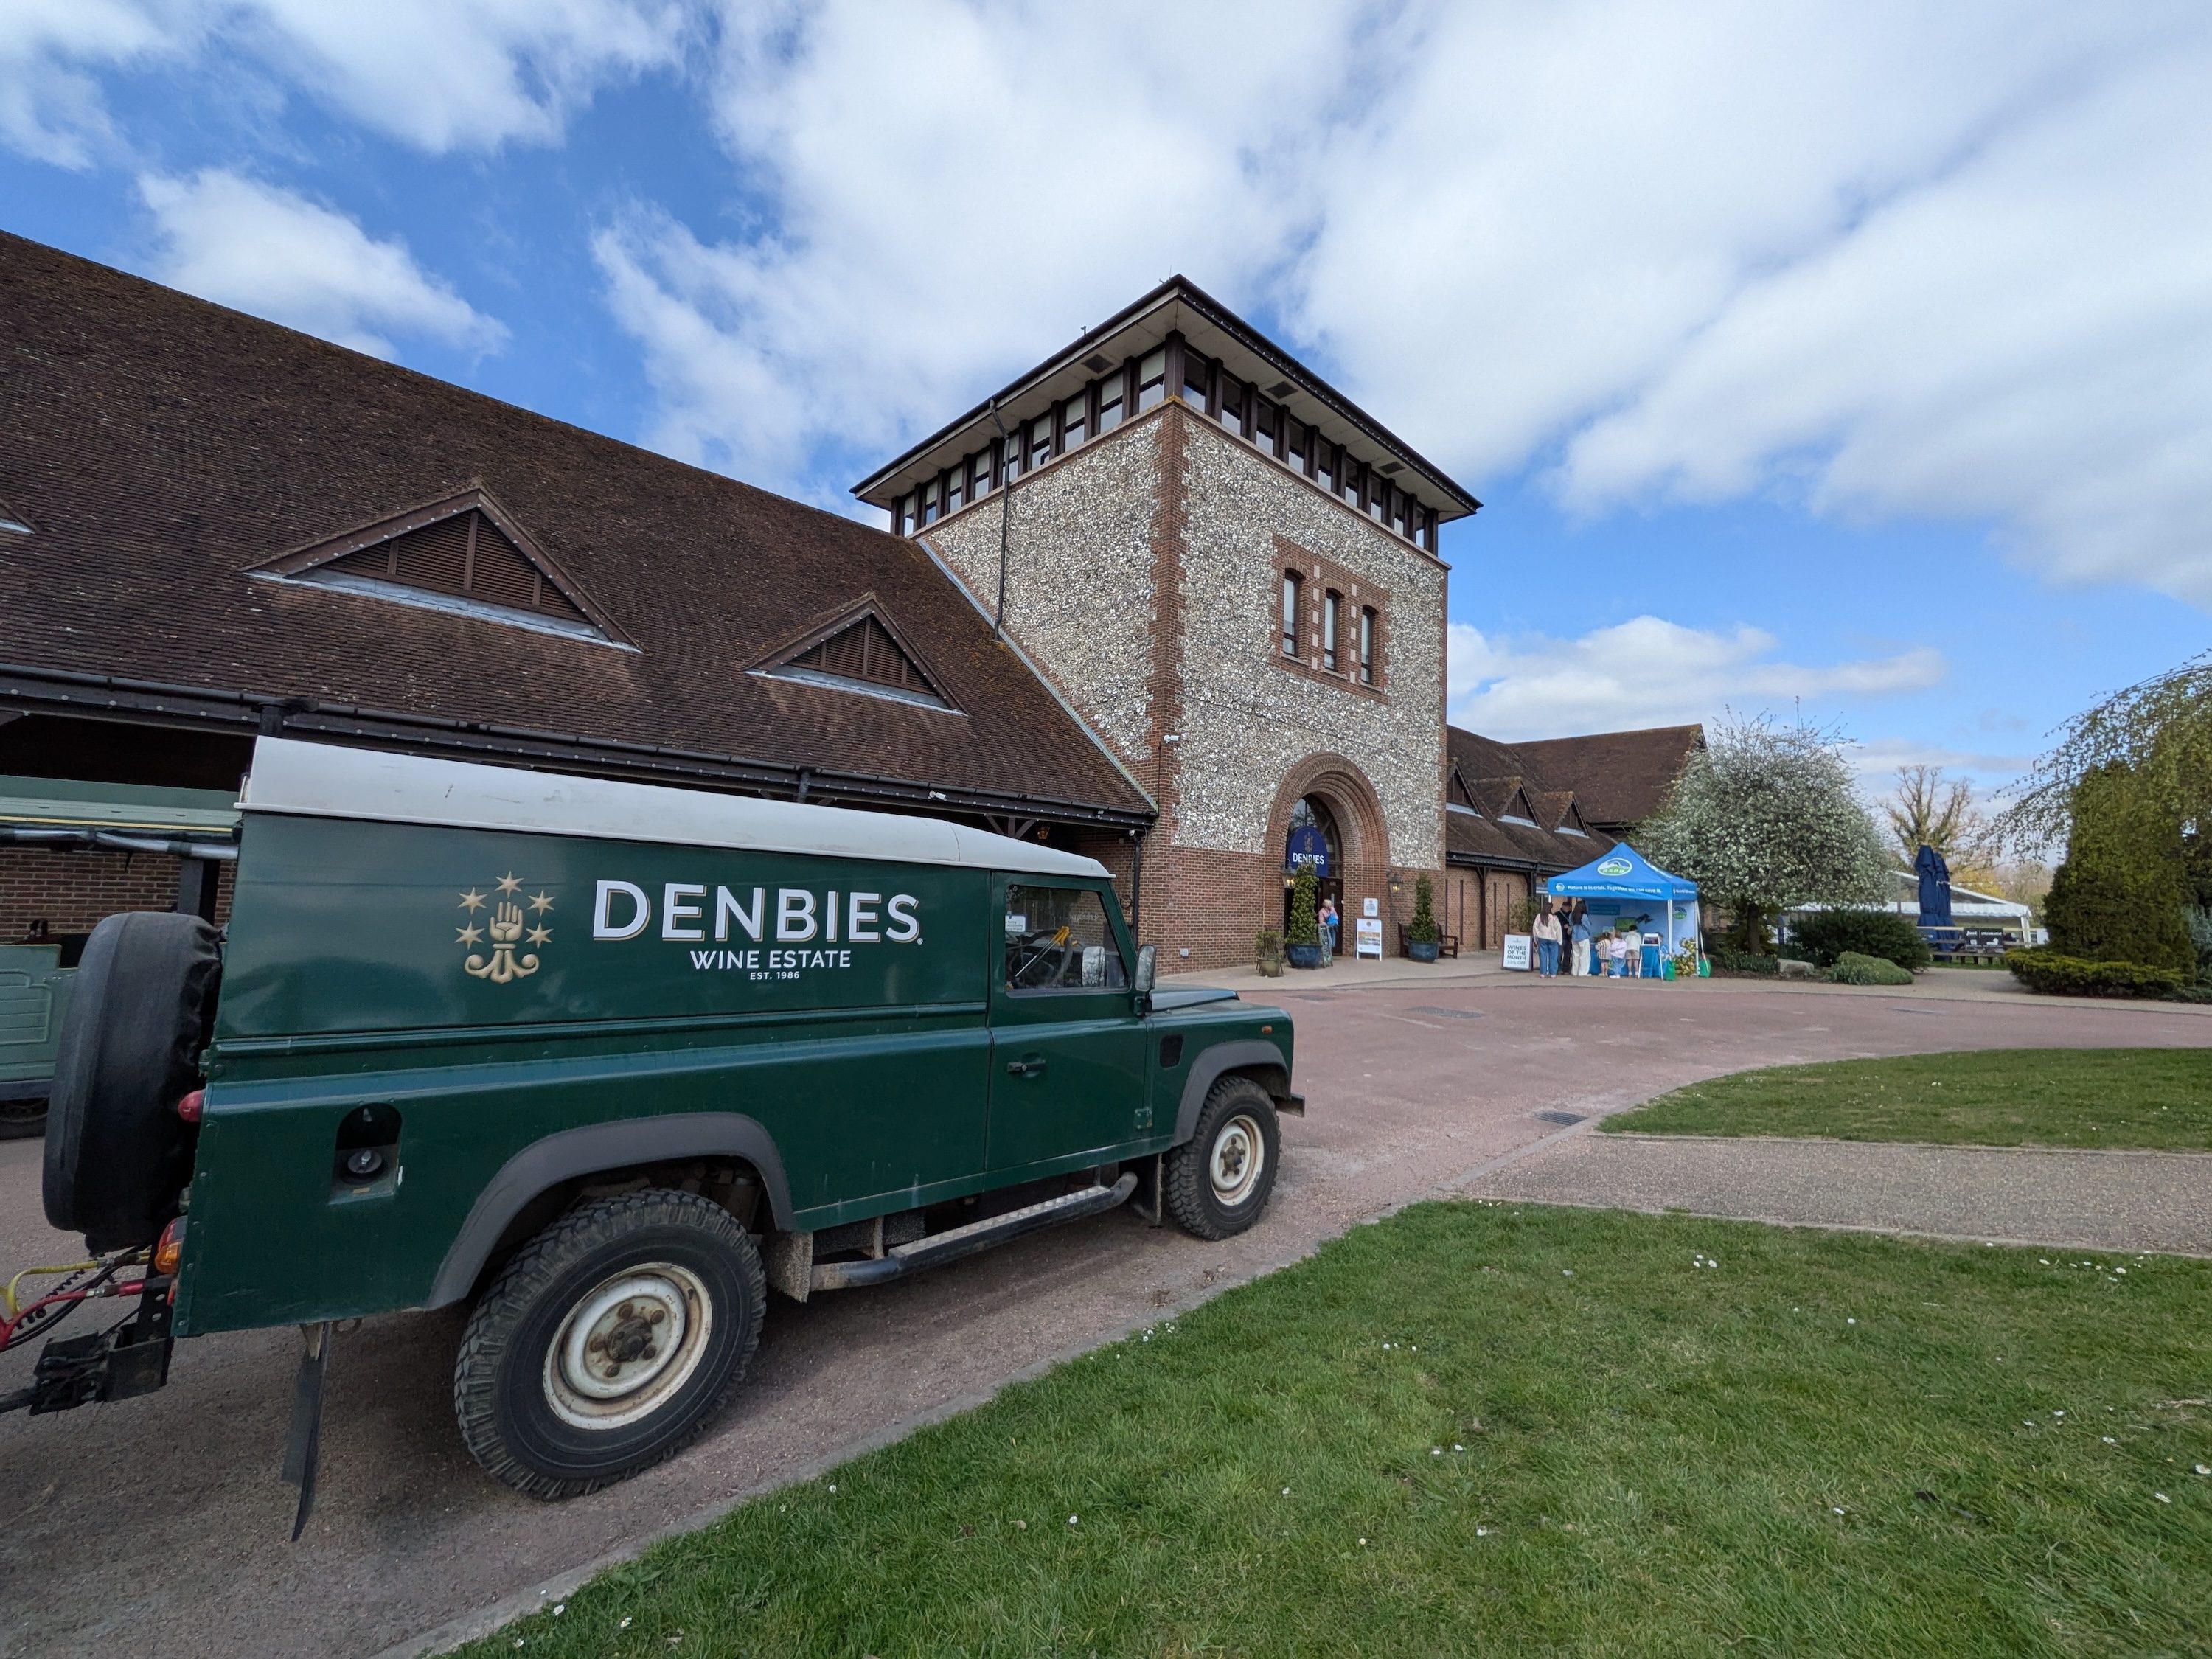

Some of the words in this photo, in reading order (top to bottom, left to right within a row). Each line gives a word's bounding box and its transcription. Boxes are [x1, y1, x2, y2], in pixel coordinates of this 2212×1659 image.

[593, 880, 919, 942] DENBIES
[690, 950, 759, 969] WINE
[769, 950, 851, 968] ESTATE
[750, 972, 773, 980] EST.
[776, 971, 800, 979] 1986
